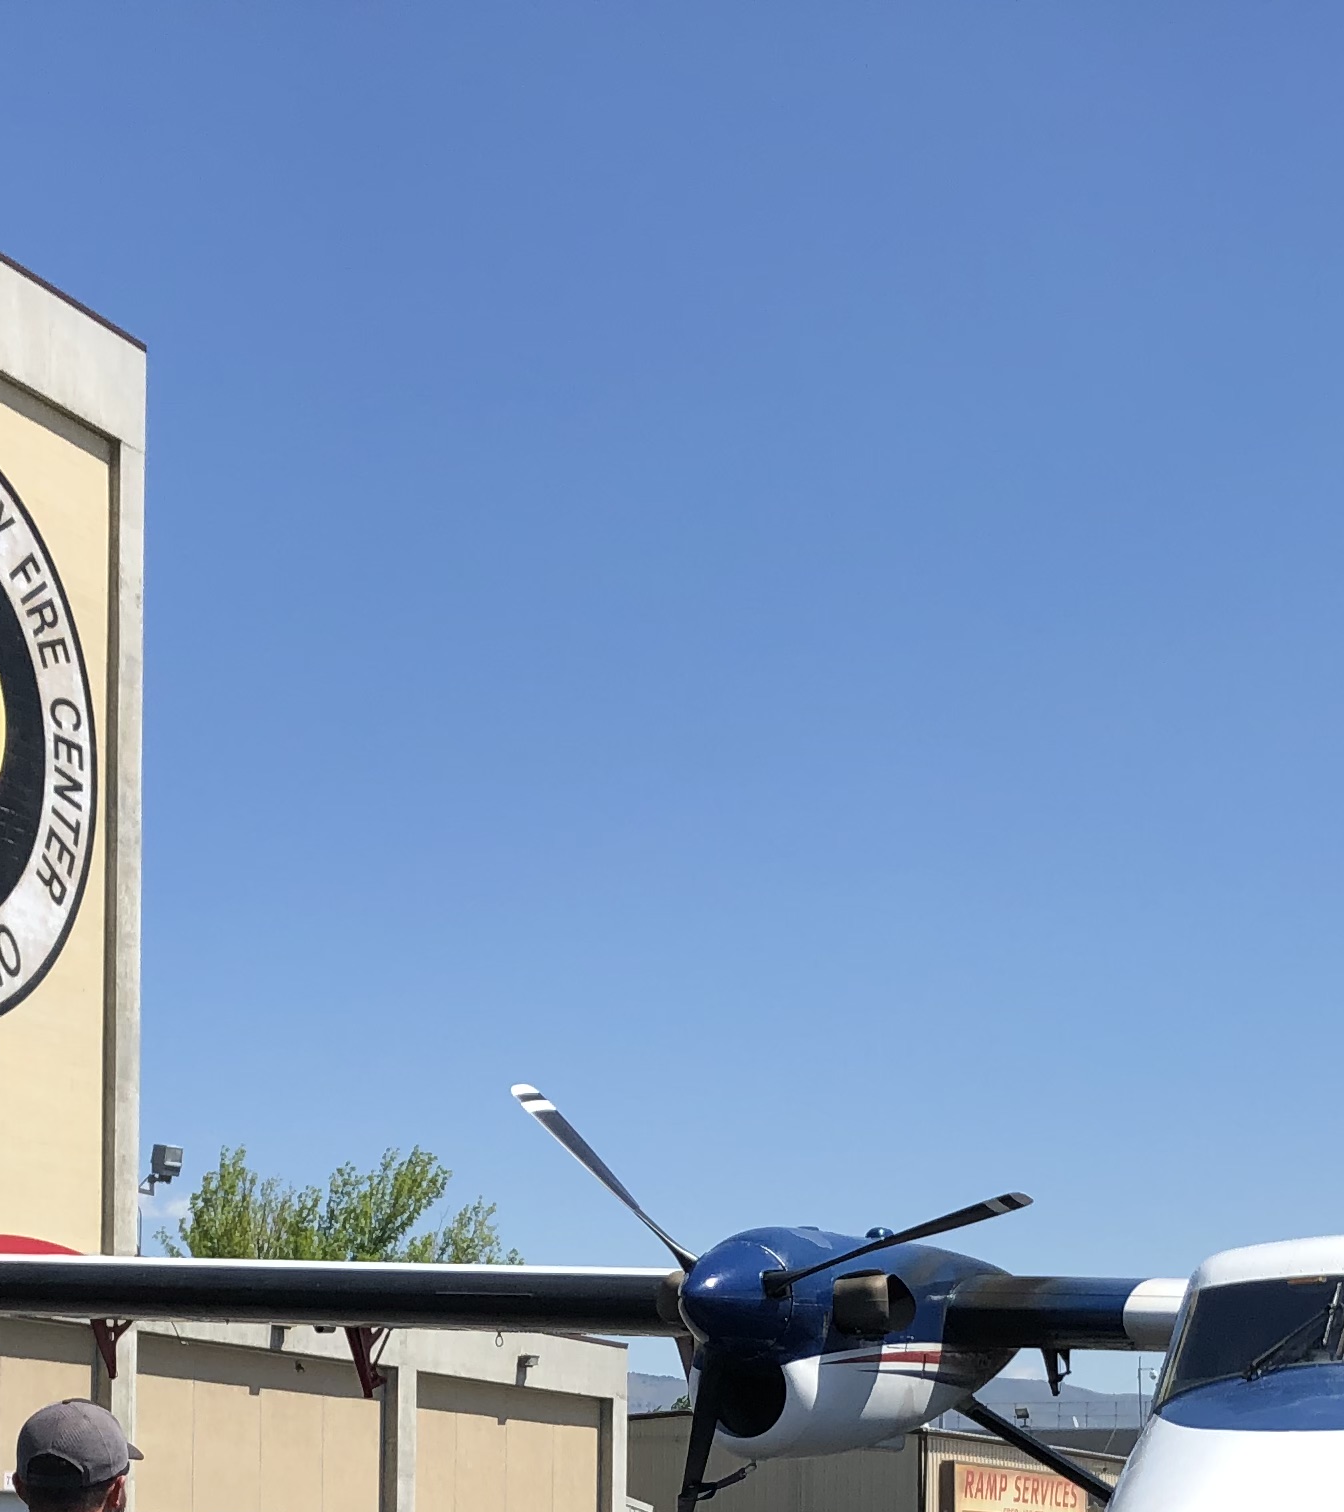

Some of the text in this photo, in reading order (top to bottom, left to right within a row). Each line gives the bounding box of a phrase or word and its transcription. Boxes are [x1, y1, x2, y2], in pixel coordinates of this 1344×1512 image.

[9, 552, 68, 669] FIRE
[36, 695, 84, 908] CENTER
[964, 1470, 1077, 1509] RAMP SERVICES
